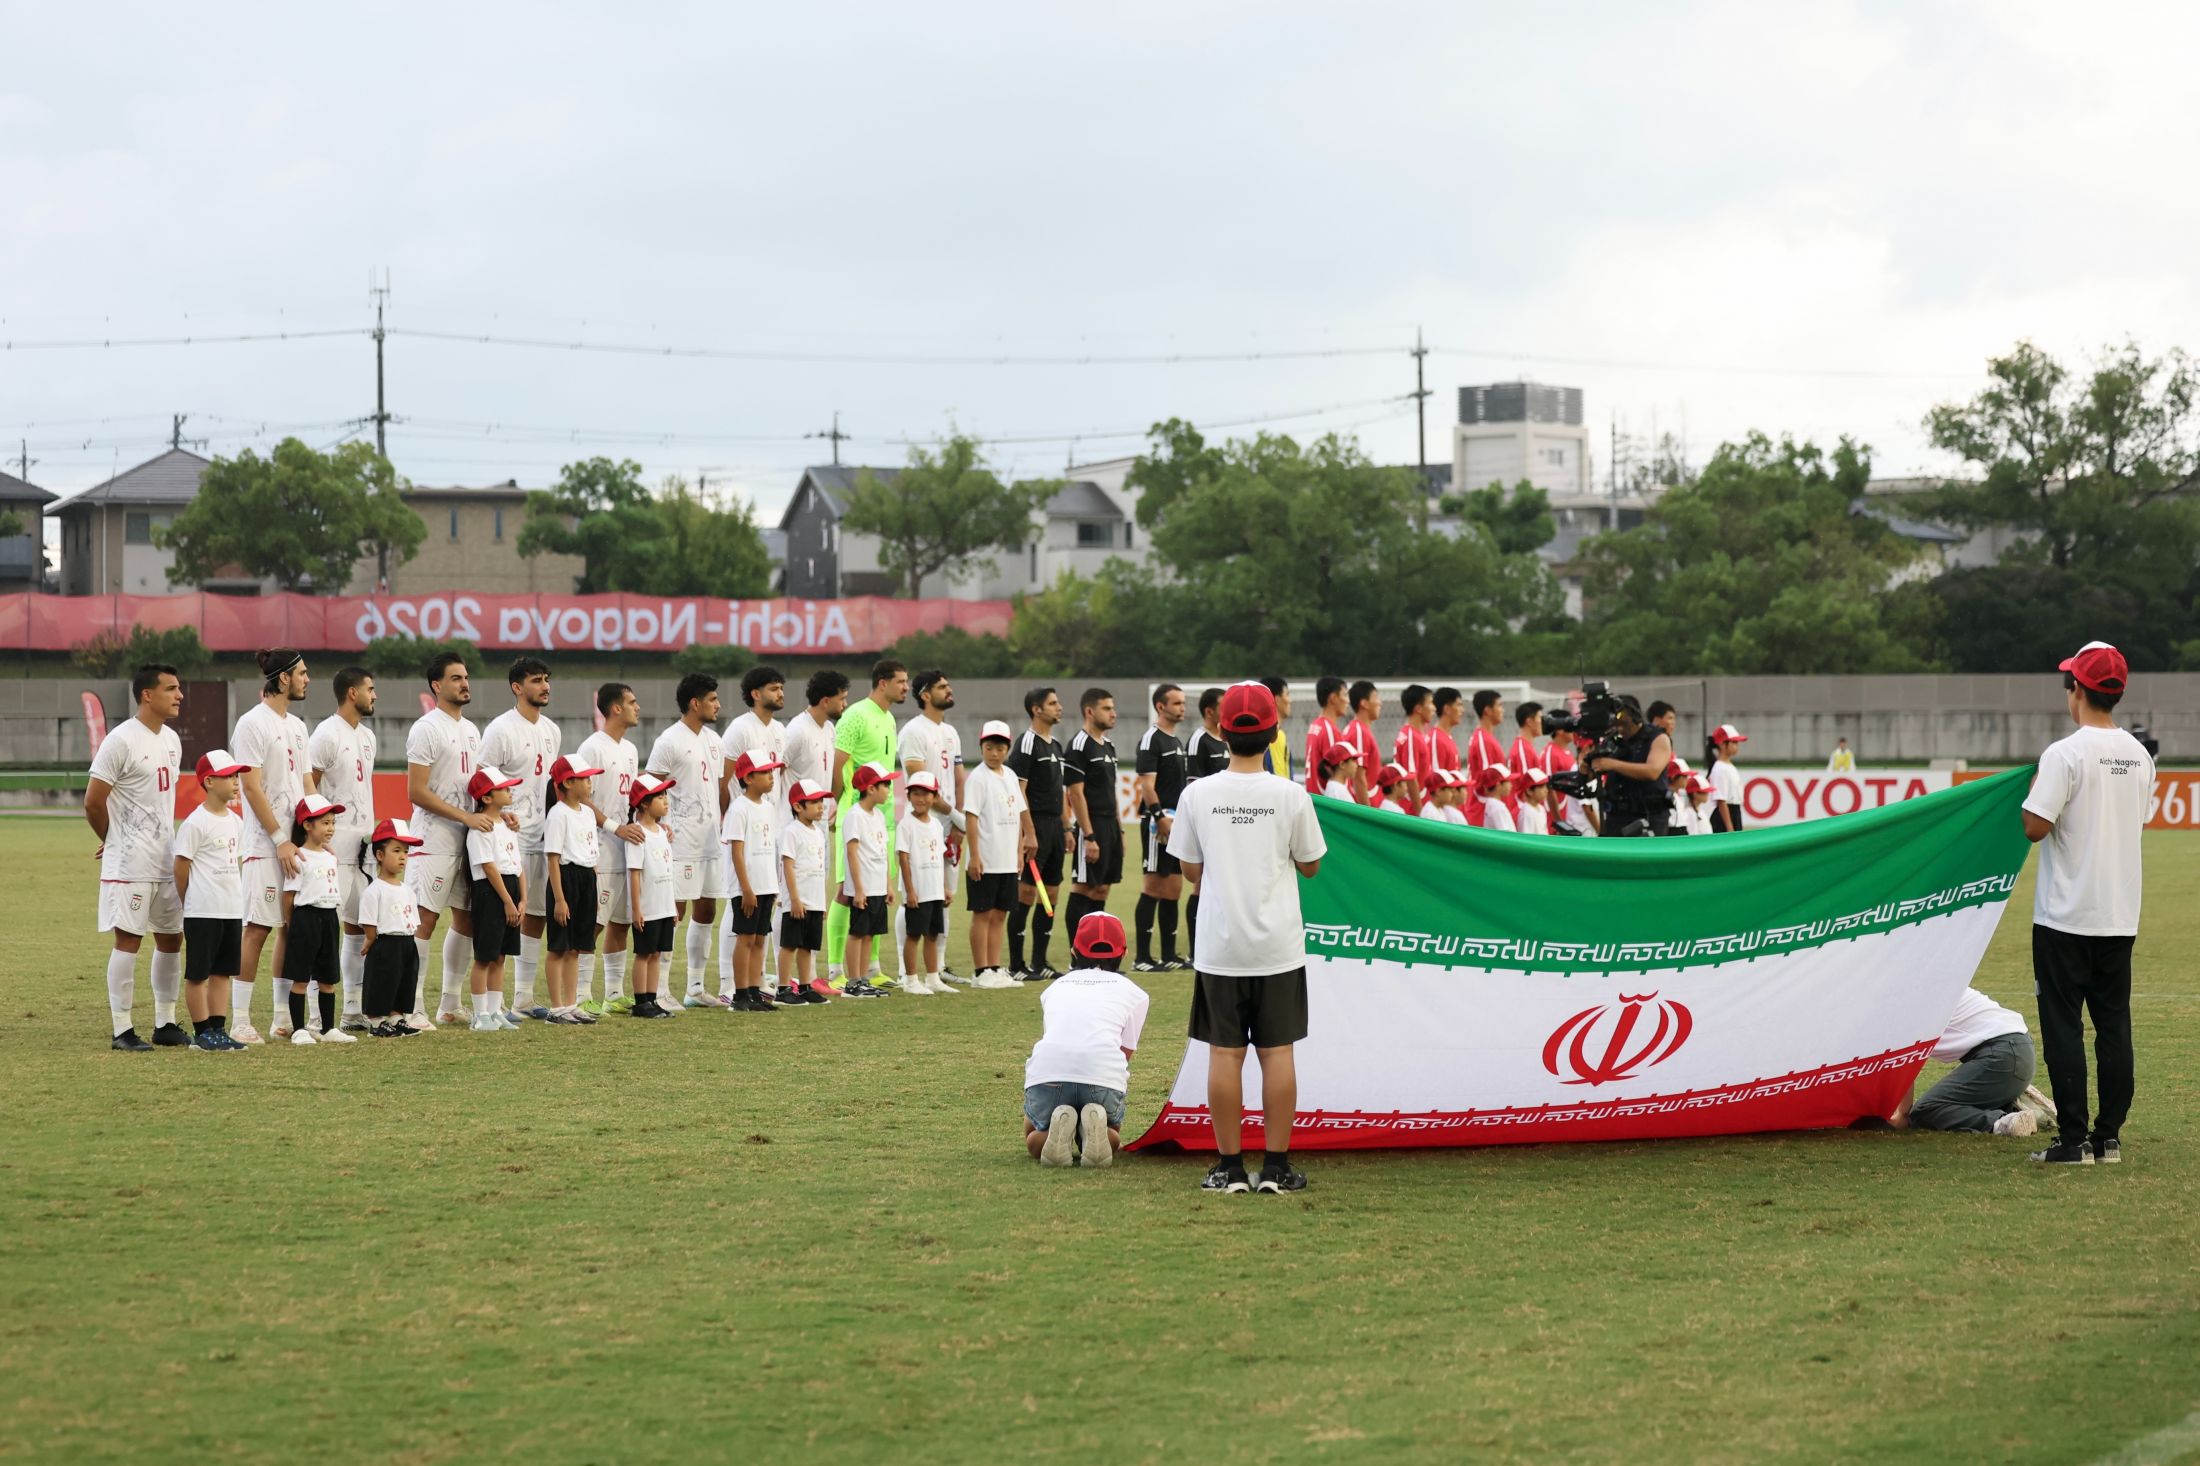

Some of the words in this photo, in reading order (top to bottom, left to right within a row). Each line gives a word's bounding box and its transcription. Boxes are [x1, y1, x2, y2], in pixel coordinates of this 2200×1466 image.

[460, 751, 469, 774] 11
[701, 760, 709, 782] 2
[2099, 757, 2141, 768] Aichi-Nagoya
[157, 766, 170, 792] 10
[1743, 777, 1928, 820] OYOTA
[1211, 805, 1275, 817] Aichi-Nagoya
[1231, 816, 1255, 824] 2026
